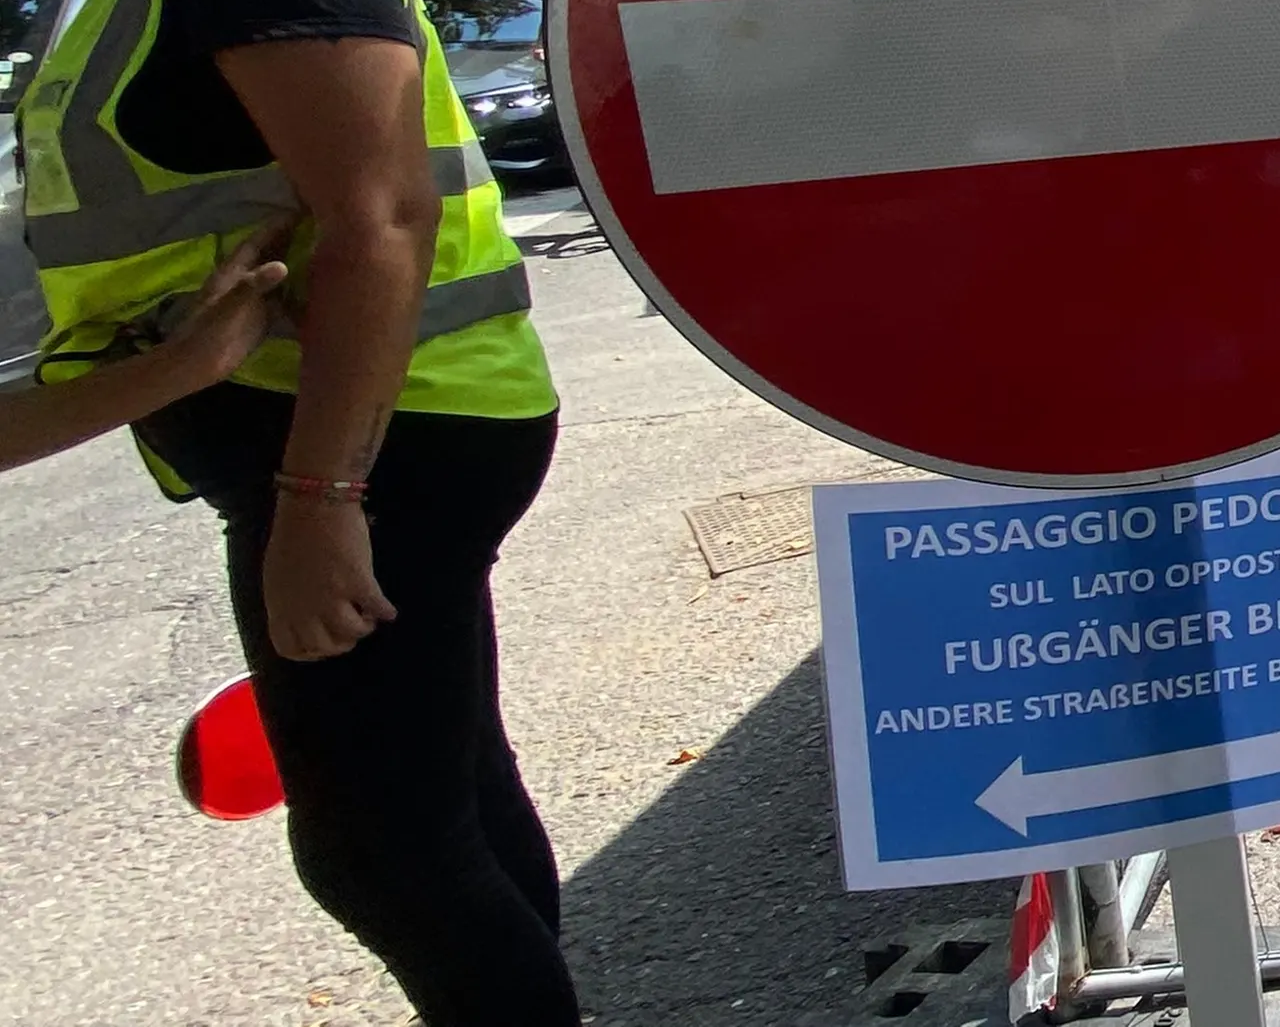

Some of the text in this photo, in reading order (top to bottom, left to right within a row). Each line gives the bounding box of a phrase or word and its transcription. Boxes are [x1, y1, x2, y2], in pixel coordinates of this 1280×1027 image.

[885, 507, 1156, 560] PASSAGGIO
[989, 579, 1054, 608] SUL
[1073, 568, 1154, 599] LATO
[945, 610, 1233, 674] FUßGÄNGER
[875, 699, 1014, 735] ANDERE
[1023, 663, 1259, 721] STRAßENSEITE
